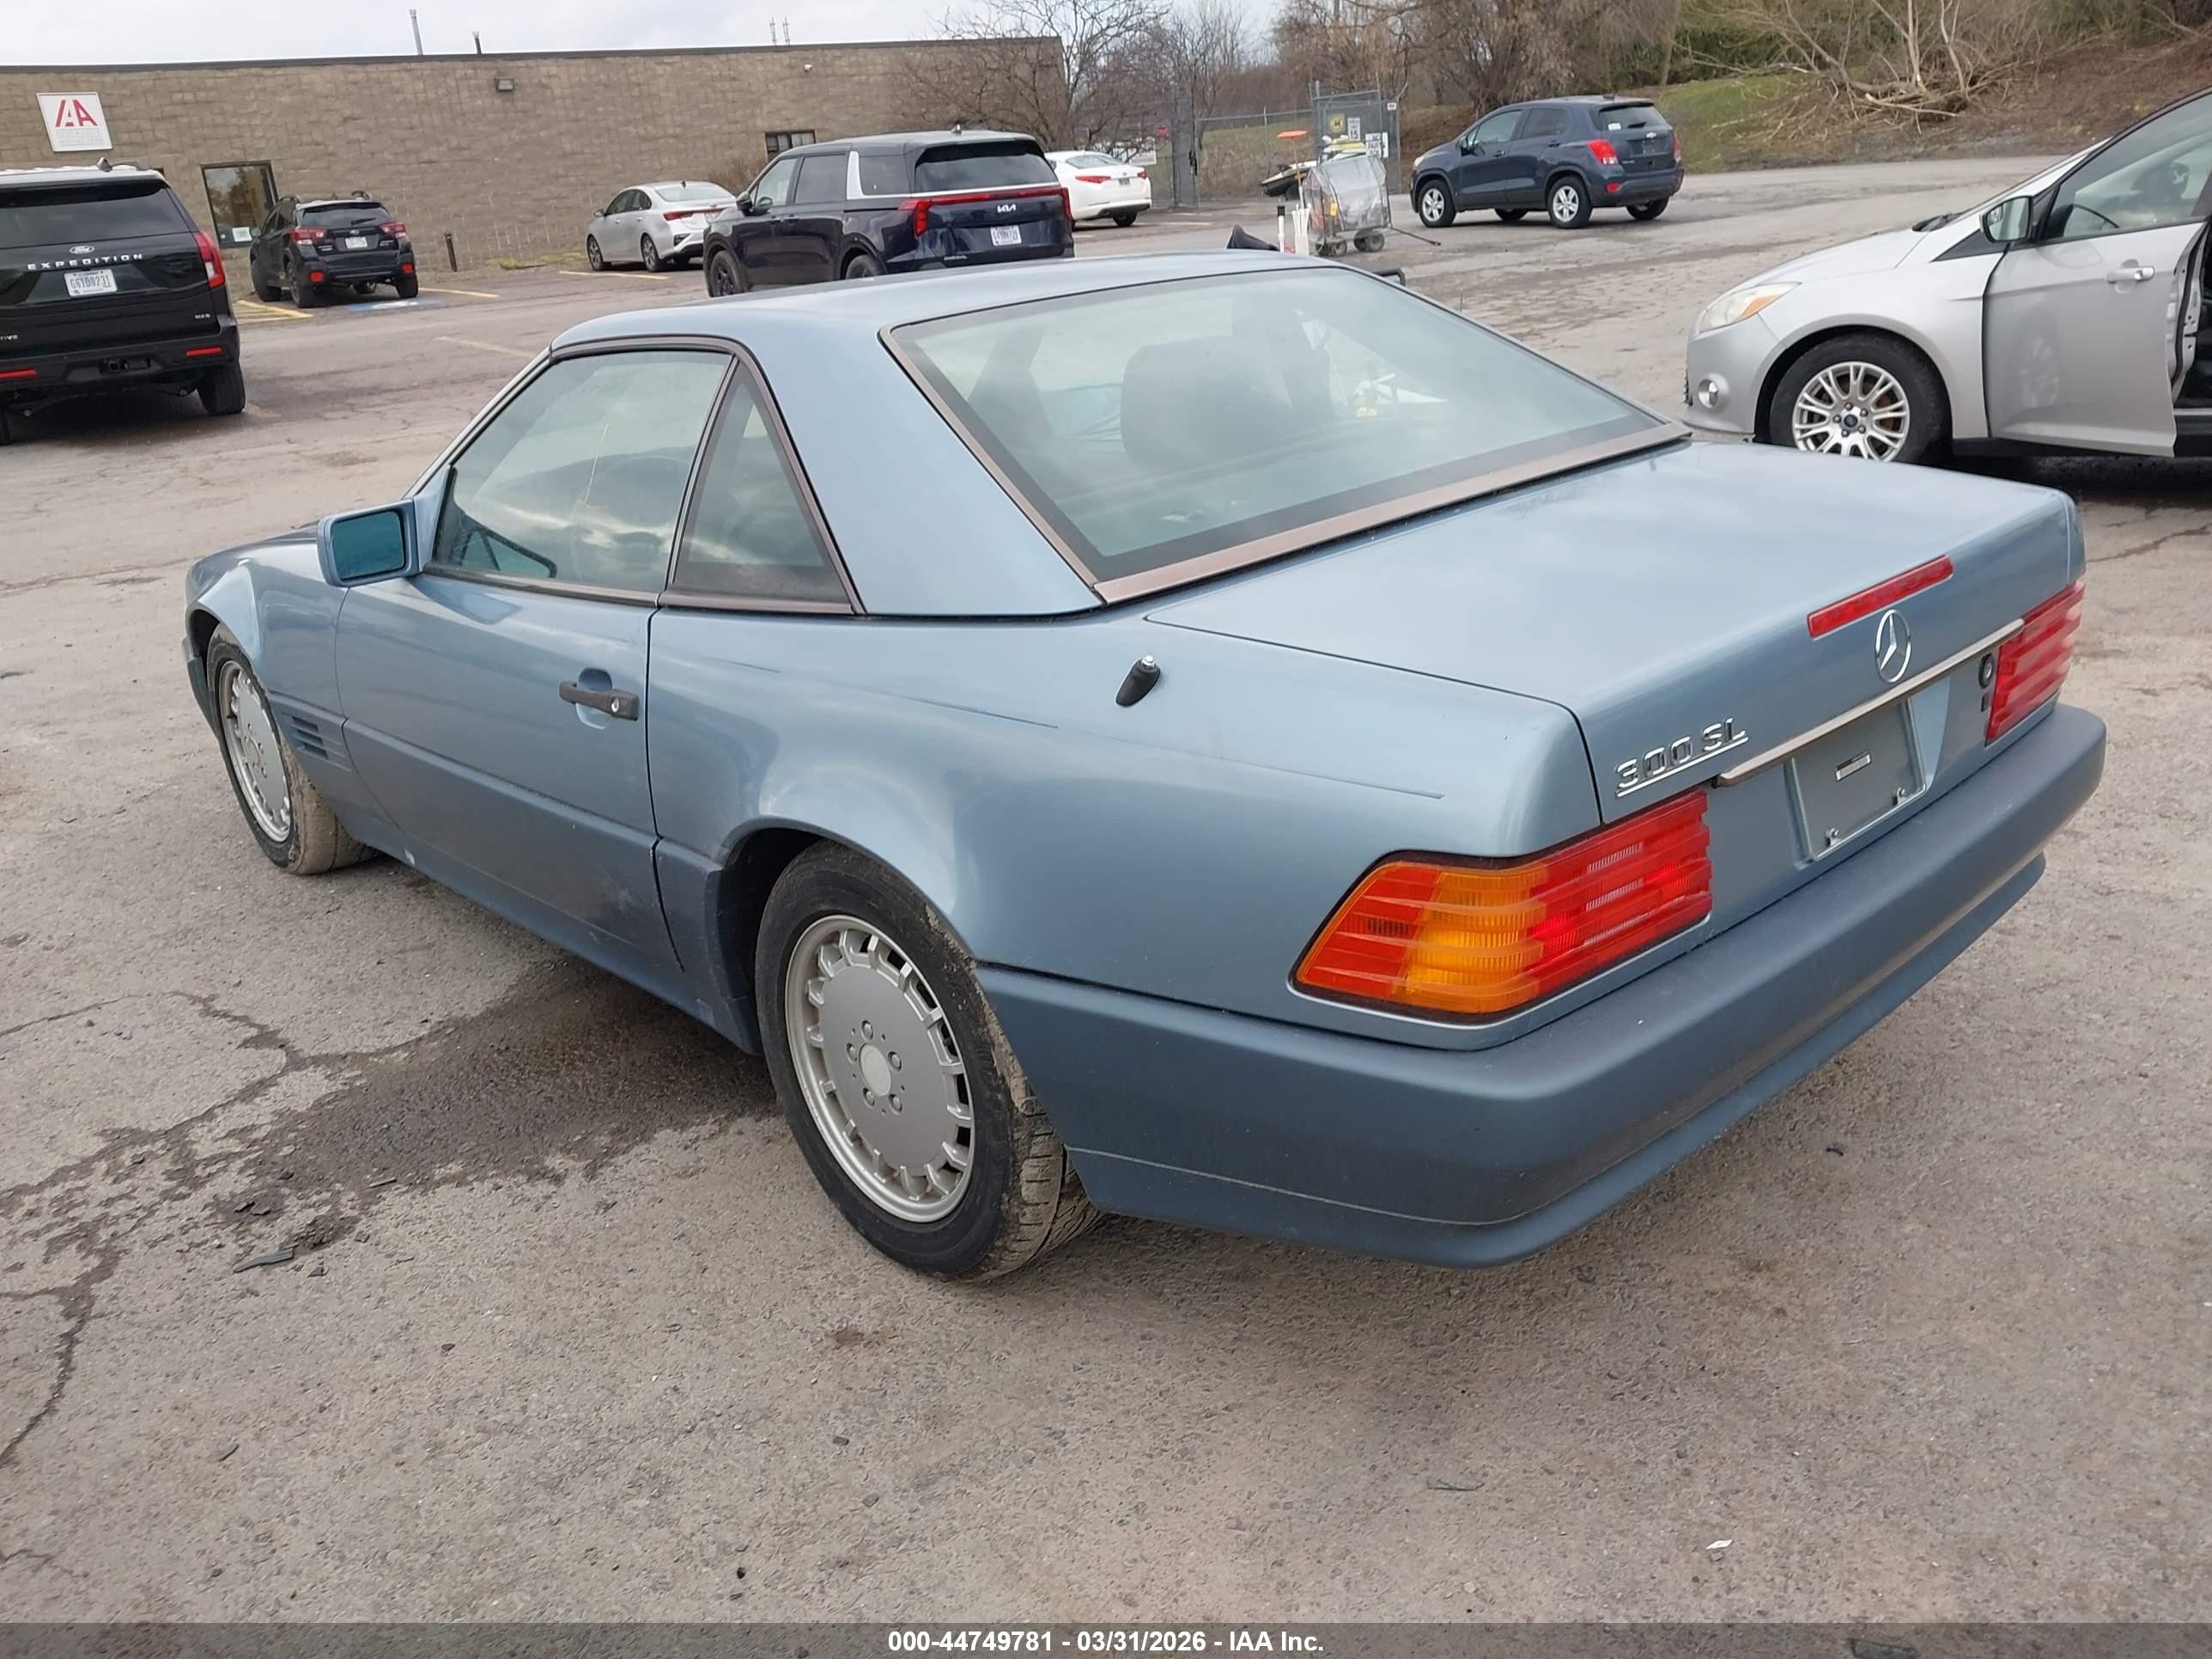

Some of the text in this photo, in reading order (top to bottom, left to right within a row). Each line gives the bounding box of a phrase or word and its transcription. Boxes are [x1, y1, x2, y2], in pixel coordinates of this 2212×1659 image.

[54, 99, 98, 127] IAA
[1350, 130, 1358, 139] 15
[997, 204, 1017, 214] KIA
[27, 253, 143, 270] EXPEDITION
[1614, 717, 1747, 788] 300 SL
